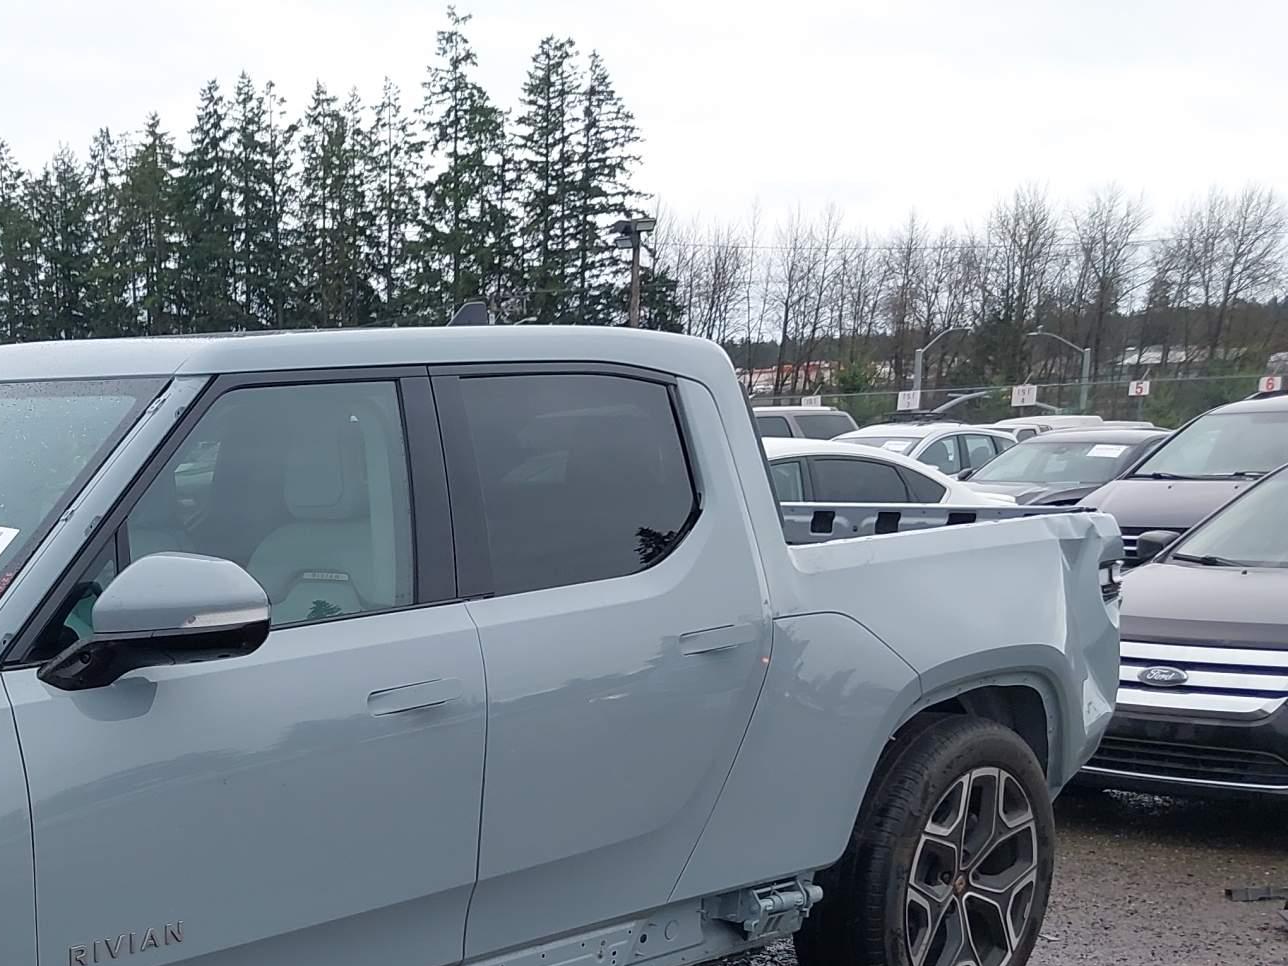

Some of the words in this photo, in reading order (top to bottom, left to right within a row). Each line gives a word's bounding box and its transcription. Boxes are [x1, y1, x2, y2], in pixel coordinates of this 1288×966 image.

[1135, 382, 1144, 395] 5
[1265, 377, 1275, 391] 6
[1146, 669, 1176, 681] Ford
